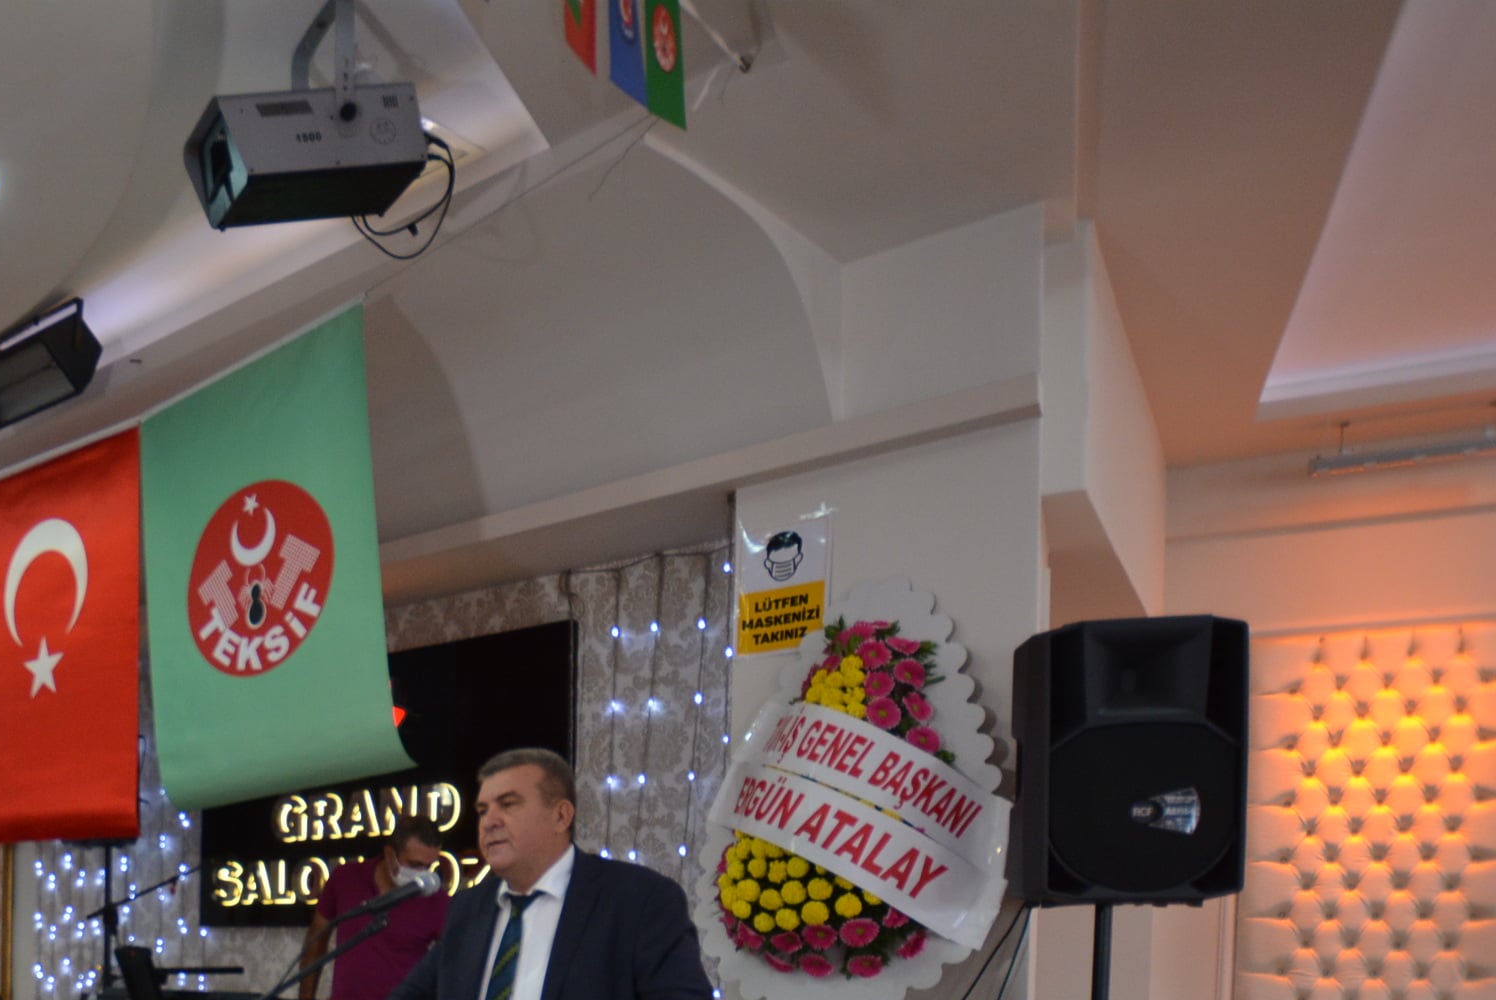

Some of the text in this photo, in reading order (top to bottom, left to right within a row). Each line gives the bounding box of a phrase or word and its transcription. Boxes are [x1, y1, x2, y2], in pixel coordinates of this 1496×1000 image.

[742, 604, 820, 631] MASKENİZİ
[755, 593, 808, 613] LÜTFEN
[752, 626, 808, 646] TAKINIZ
[796, 718, 876, 779] GENEL
[867, 751, 983, 839] BAŞKANI
[279, 782, 461, 843] GRAND
[734, 776, 949, 899] ERGÜN ATALAY
[215, 856, 366, 907] SALO
